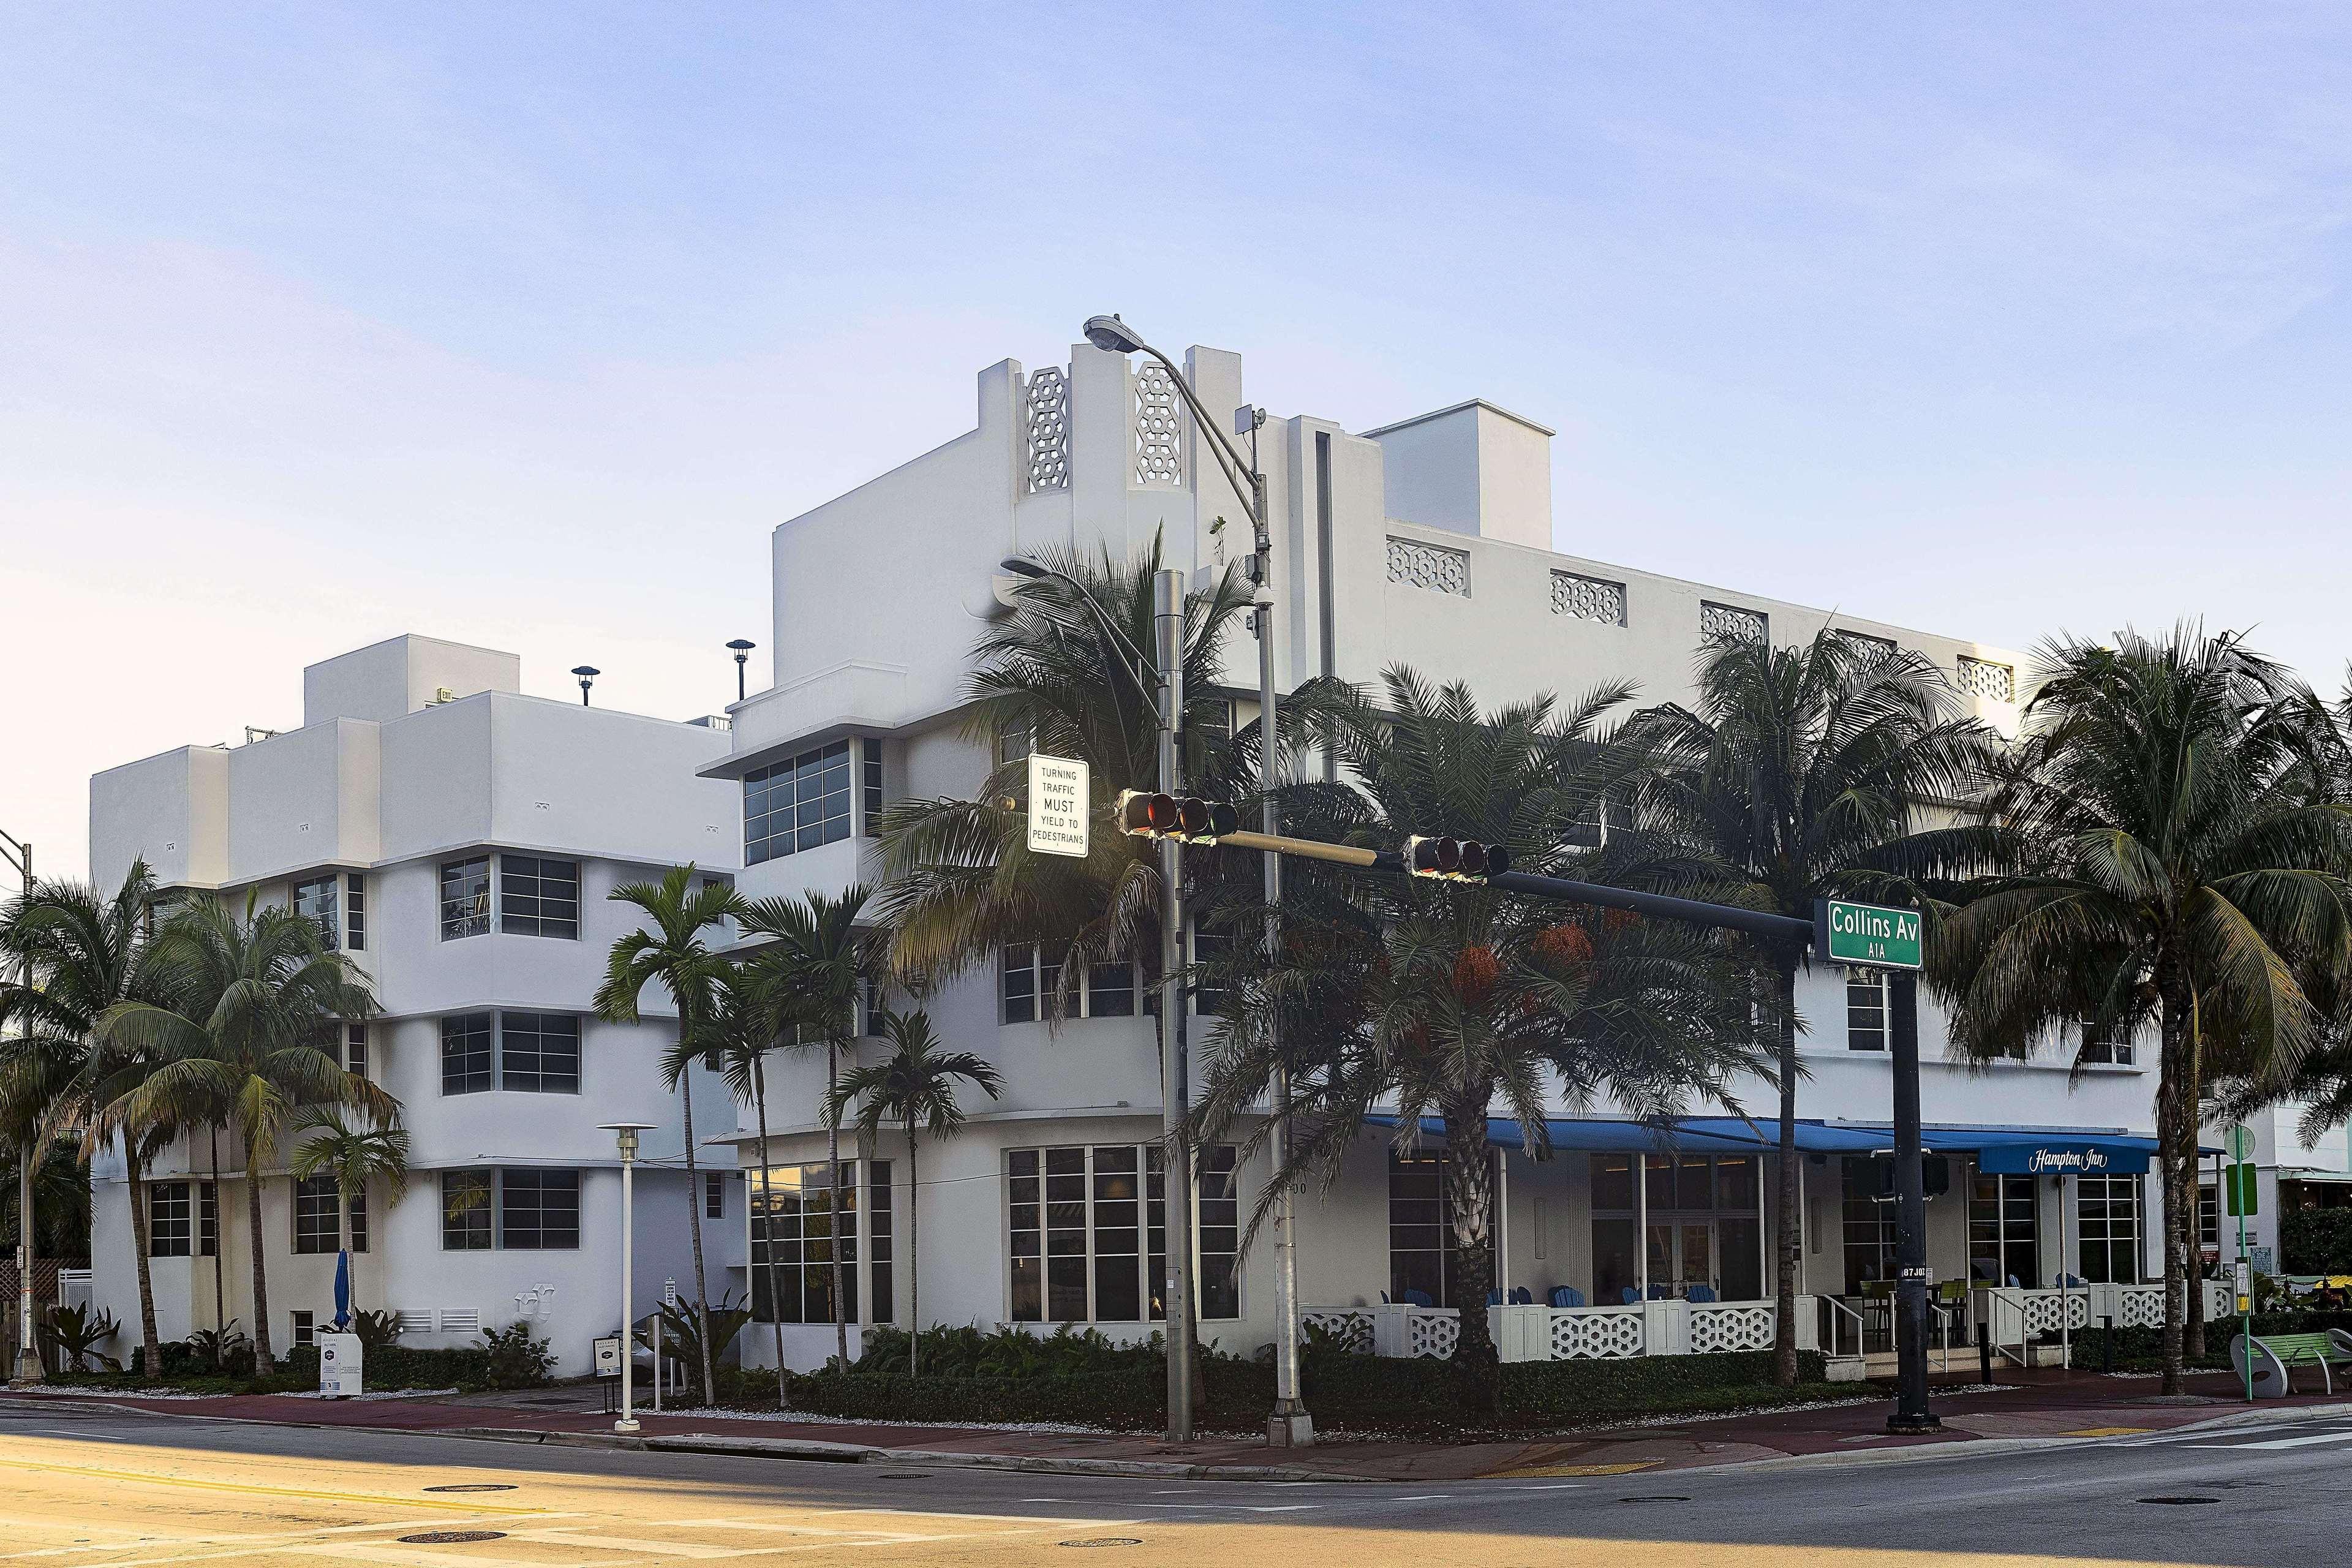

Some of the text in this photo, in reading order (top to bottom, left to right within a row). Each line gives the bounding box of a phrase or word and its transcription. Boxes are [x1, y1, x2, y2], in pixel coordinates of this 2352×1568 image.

[442, 691, 451, 700] EXIT
[1042, 767, 1077, 780] TURNING
[1042, 783, 1075, 795] TRAFFIC
[1044, 798, 1074, 813] MUST
[1041, 816, 1078, 829] YIELD TO
[1033, 830, 1084, 845] PEDESTRIANS
[1832, 906, 1917, 941] Collins Av
[1868, 942, 1885, 959] A1A
[2029, 1148, 2108, 1172] Hampton Inn
